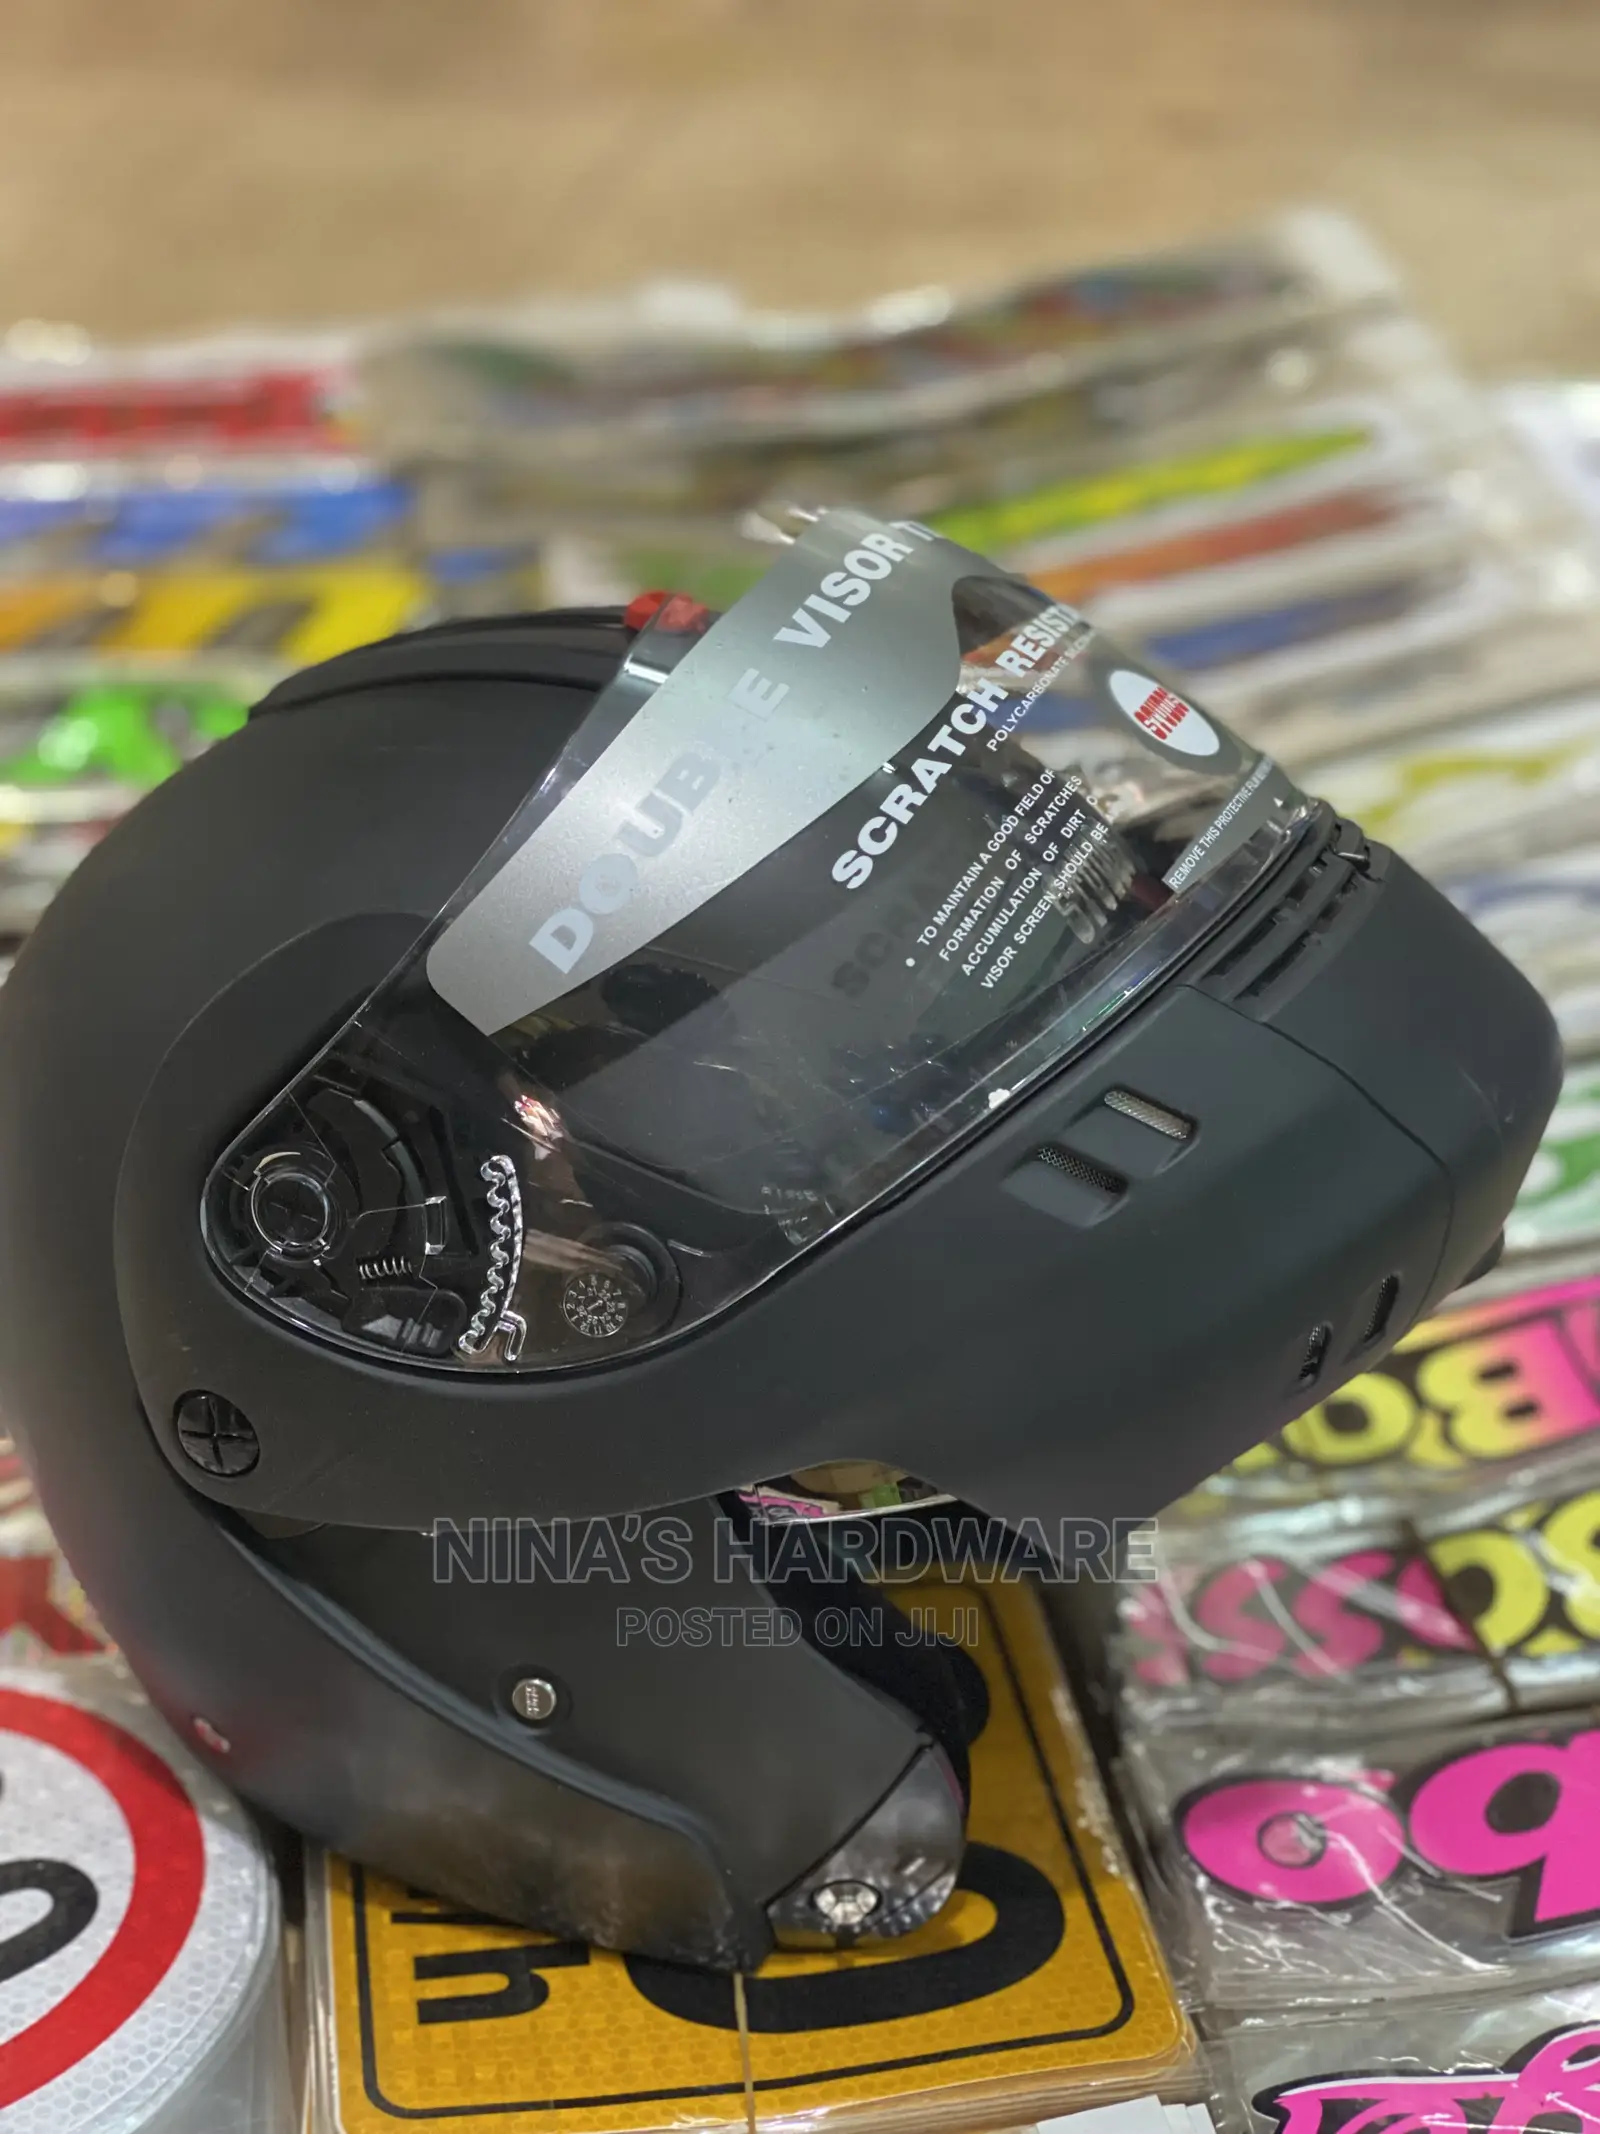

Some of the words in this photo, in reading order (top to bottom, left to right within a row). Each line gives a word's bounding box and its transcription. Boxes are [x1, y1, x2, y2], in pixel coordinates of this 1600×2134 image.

[529, 667, 790, 974] DOUBE
[773, 532, 914, 649] VISOR
[831, 676, 1008, 891] SCRATCH
[986, 655, 1069, 752] POLYCARBONATE
[917, 925, 938, 946] TO
[933, 862, 983, 925] MAINTAIN
[980, 853, 992, 864] A
[988, 816, 1019, 851] GOOD
[1015, 784, 1044, 816] FIELD
[939, 876, 1004, 961] FORMATION
[1005, 849, 1021, 870] OF
[1024, 775, 1082, 845] SCRATCHES
[962, 868, 1042, 975] ACCUMULATION
[1043, 842, 1058, 861] OF
[1061, 809, 1085, 838] DIRT
[981, 946, 1017, 988] VISOR
[1014, 891, 1059, 944] SCREEN
[1052, 841, 1093, 890] SHOULD
[1090, 823, 1108, 841] BE
[1167, 845, 1206, 889] REMOVE
[1198, 825, 1221, 850] THIS
[1213, 785, 1253, 831] PROTECTIVE
